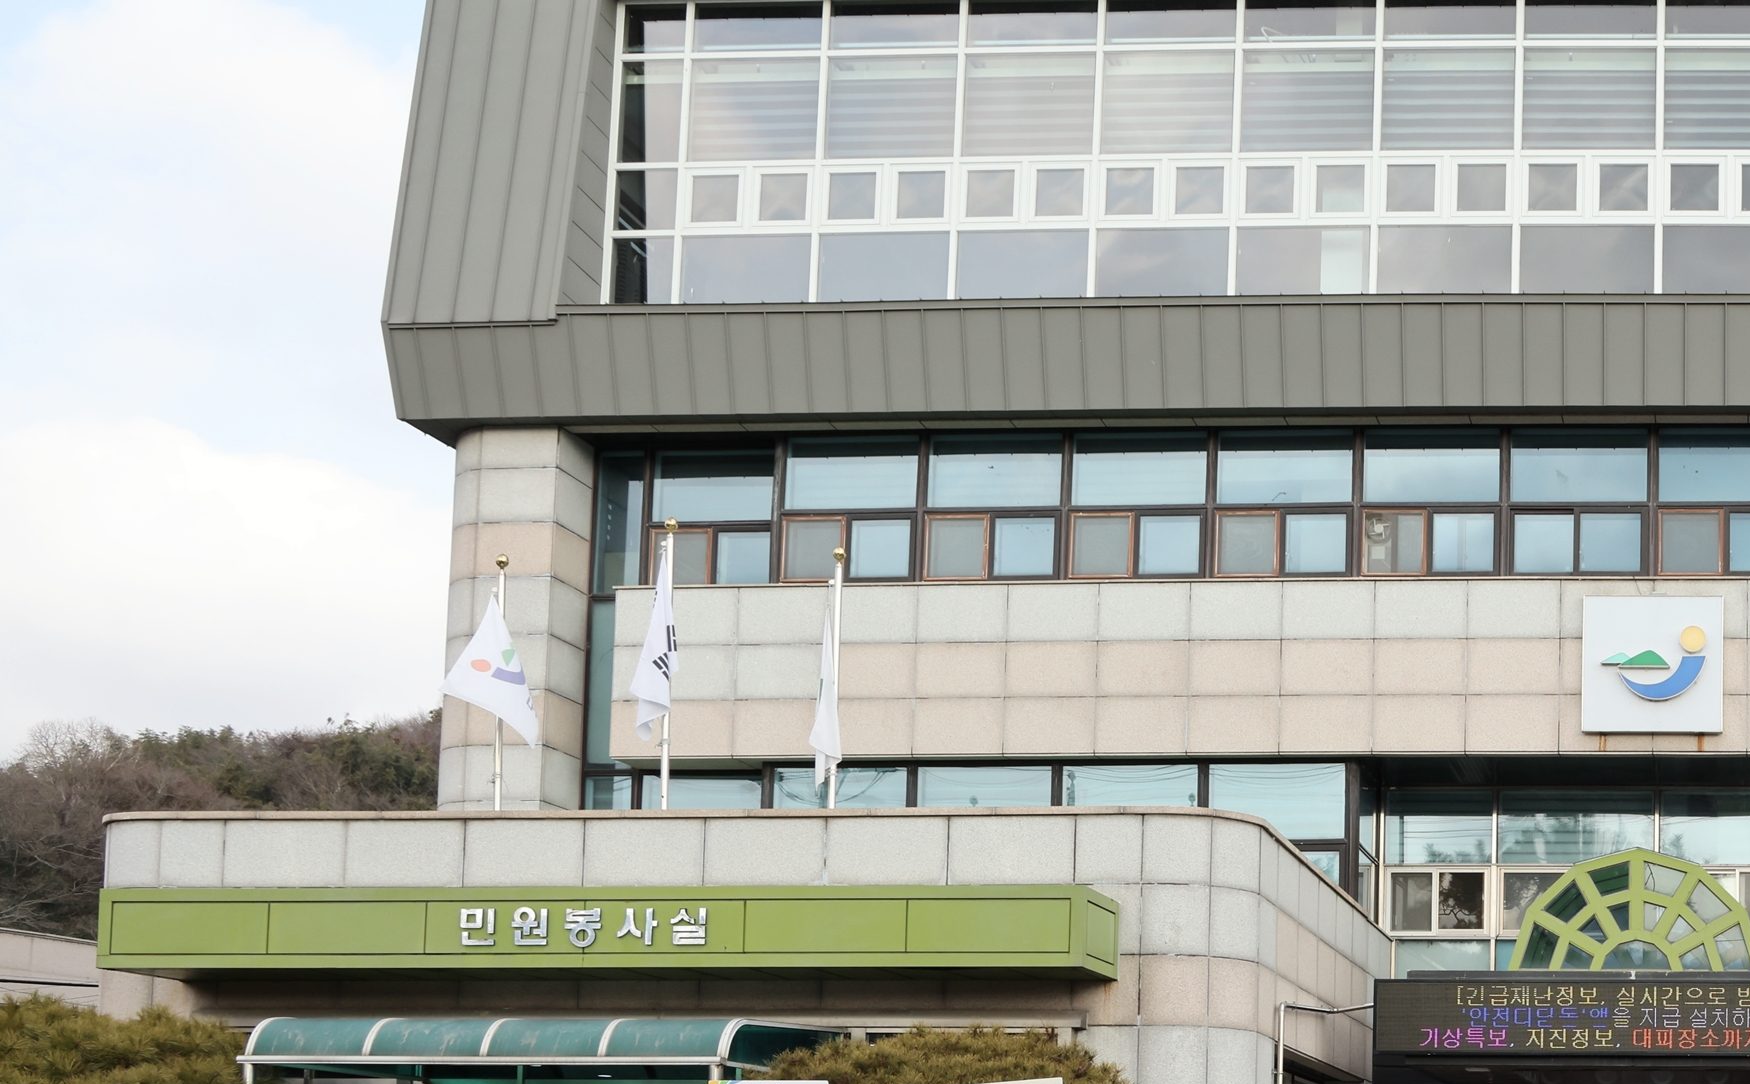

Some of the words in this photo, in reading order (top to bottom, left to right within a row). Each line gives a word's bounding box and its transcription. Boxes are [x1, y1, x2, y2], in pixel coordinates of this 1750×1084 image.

[460, 907, 707, 948] 민원봉사실
[1457, 985, 1605, 1006] [긴급재난정보,
[1617, 986, 1727, 1006] 실시간으로
[1419, 1028, 1515, 1048] 기상특보,
[1526, 1029, 1620, 1048] 지진정보,
